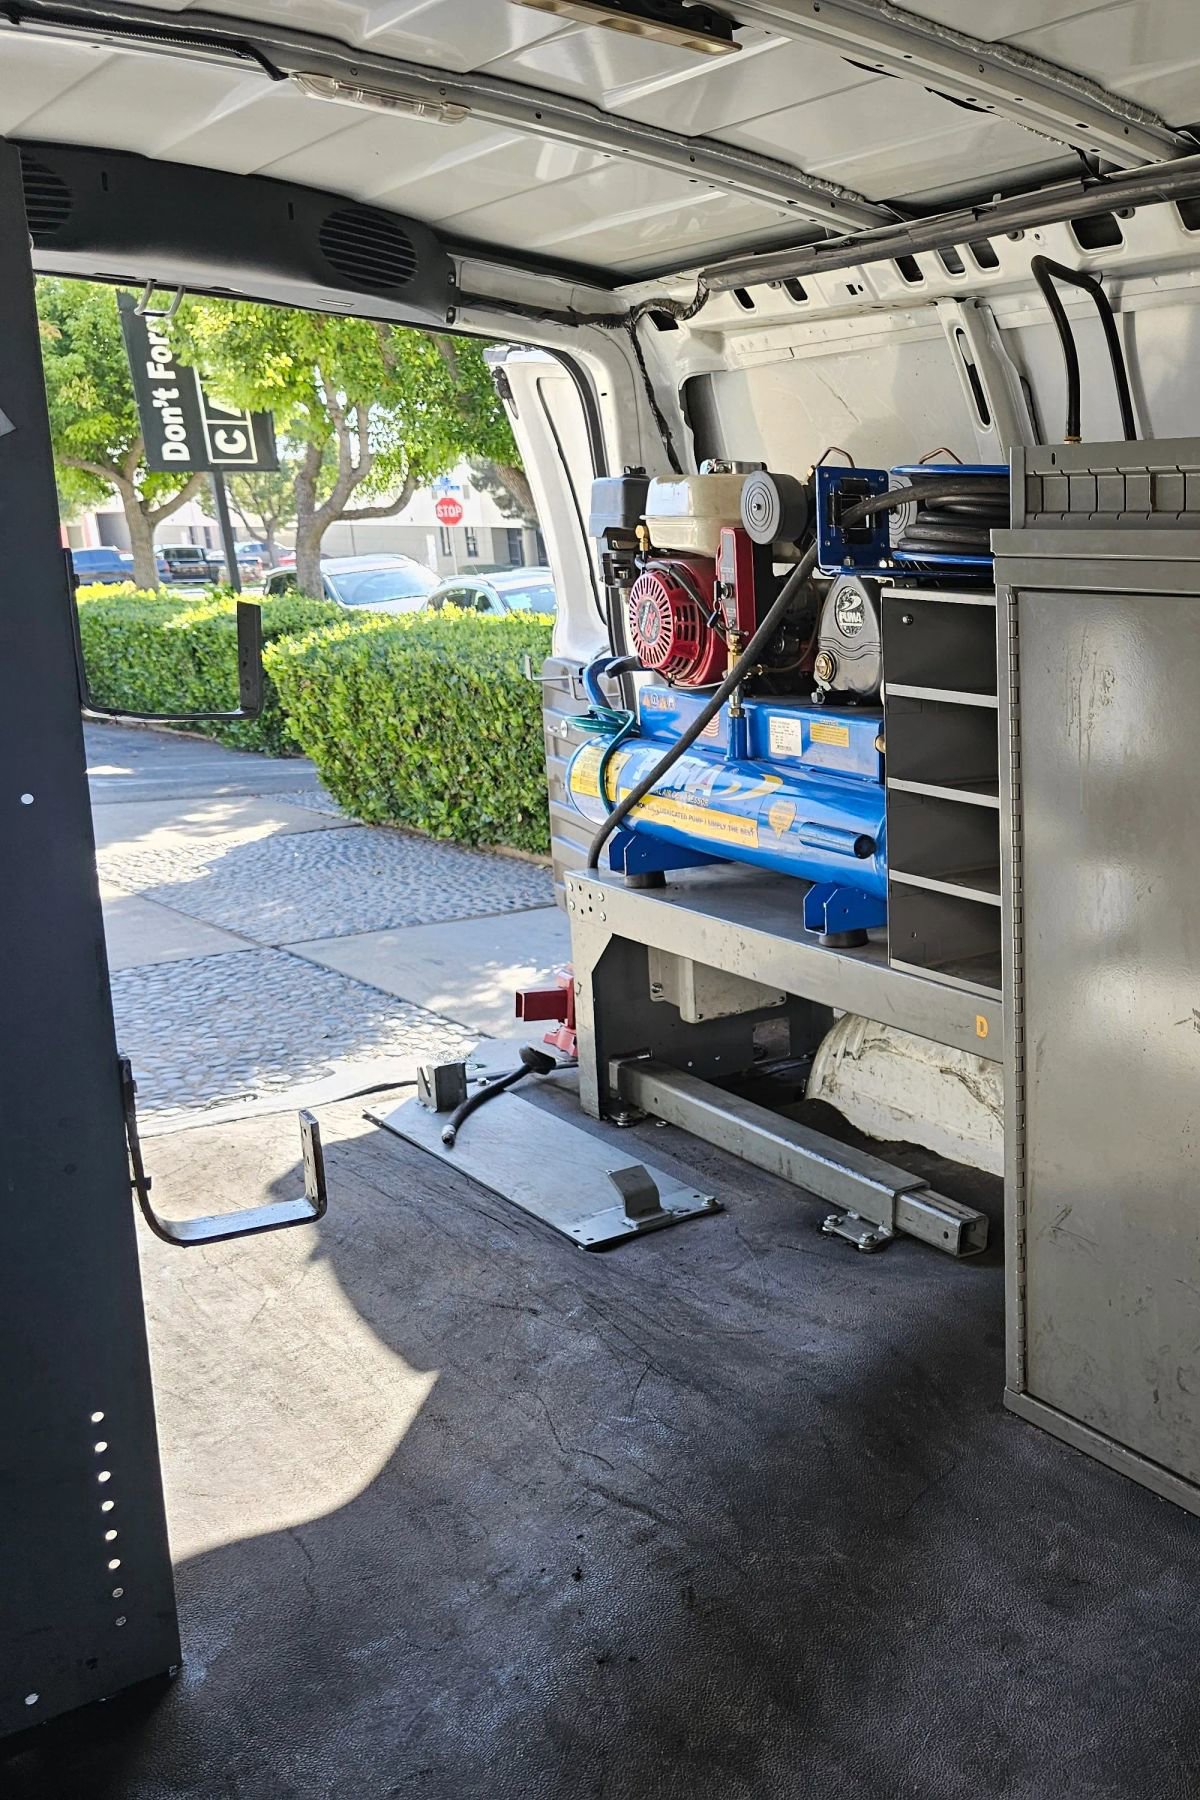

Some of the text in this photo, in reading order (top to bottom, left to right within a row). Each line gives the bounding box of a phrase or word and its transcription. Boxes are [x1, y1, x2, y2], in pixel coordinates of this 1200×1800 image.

[152, 387, 191, 461] Don't
[436, 504, 462, 518] STOP
[975, 1014, 989, 1038] D
